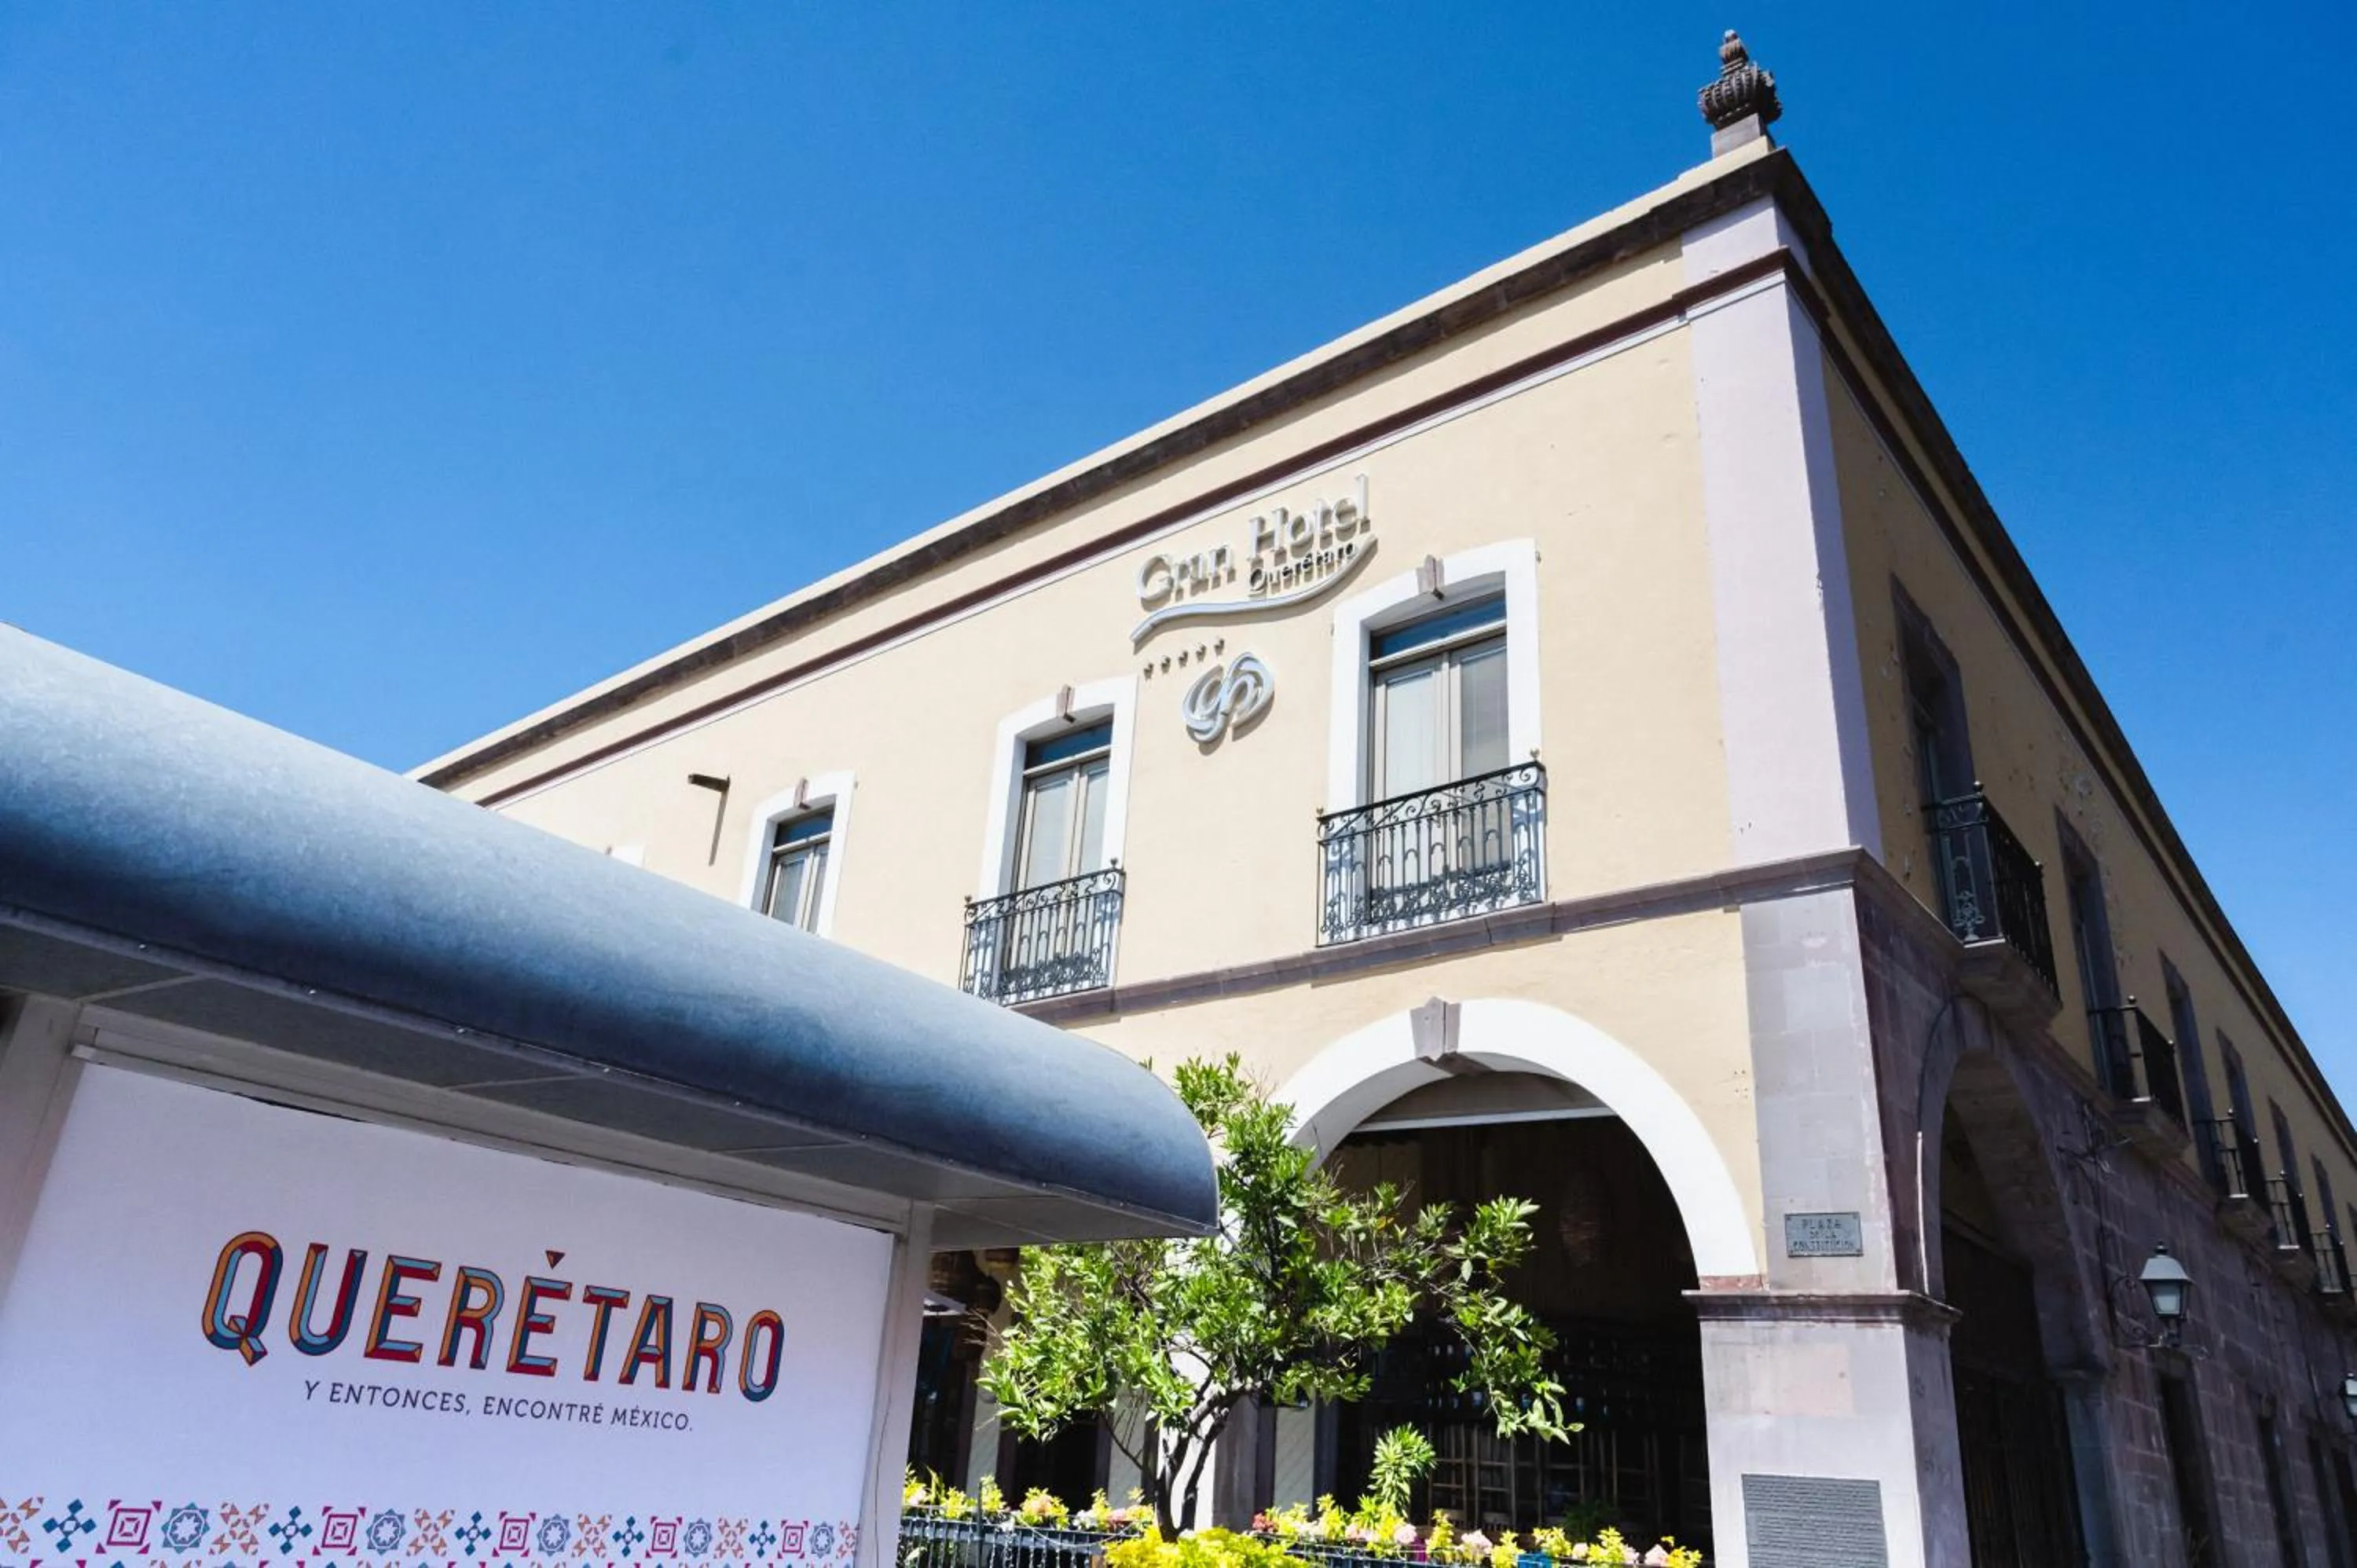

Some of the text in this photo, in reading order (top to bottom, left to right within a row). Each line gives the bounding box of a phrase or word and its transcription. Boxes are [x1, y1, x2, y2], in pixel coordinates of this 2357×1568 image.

[1136, 472, 1370, 602] Gran Hotel
[201, 1230, 785, 1402] QUERÉTARO
[305, 1379, 693, 1432] Y ENTONCES, ENCONTRÉ MÉXICO.
